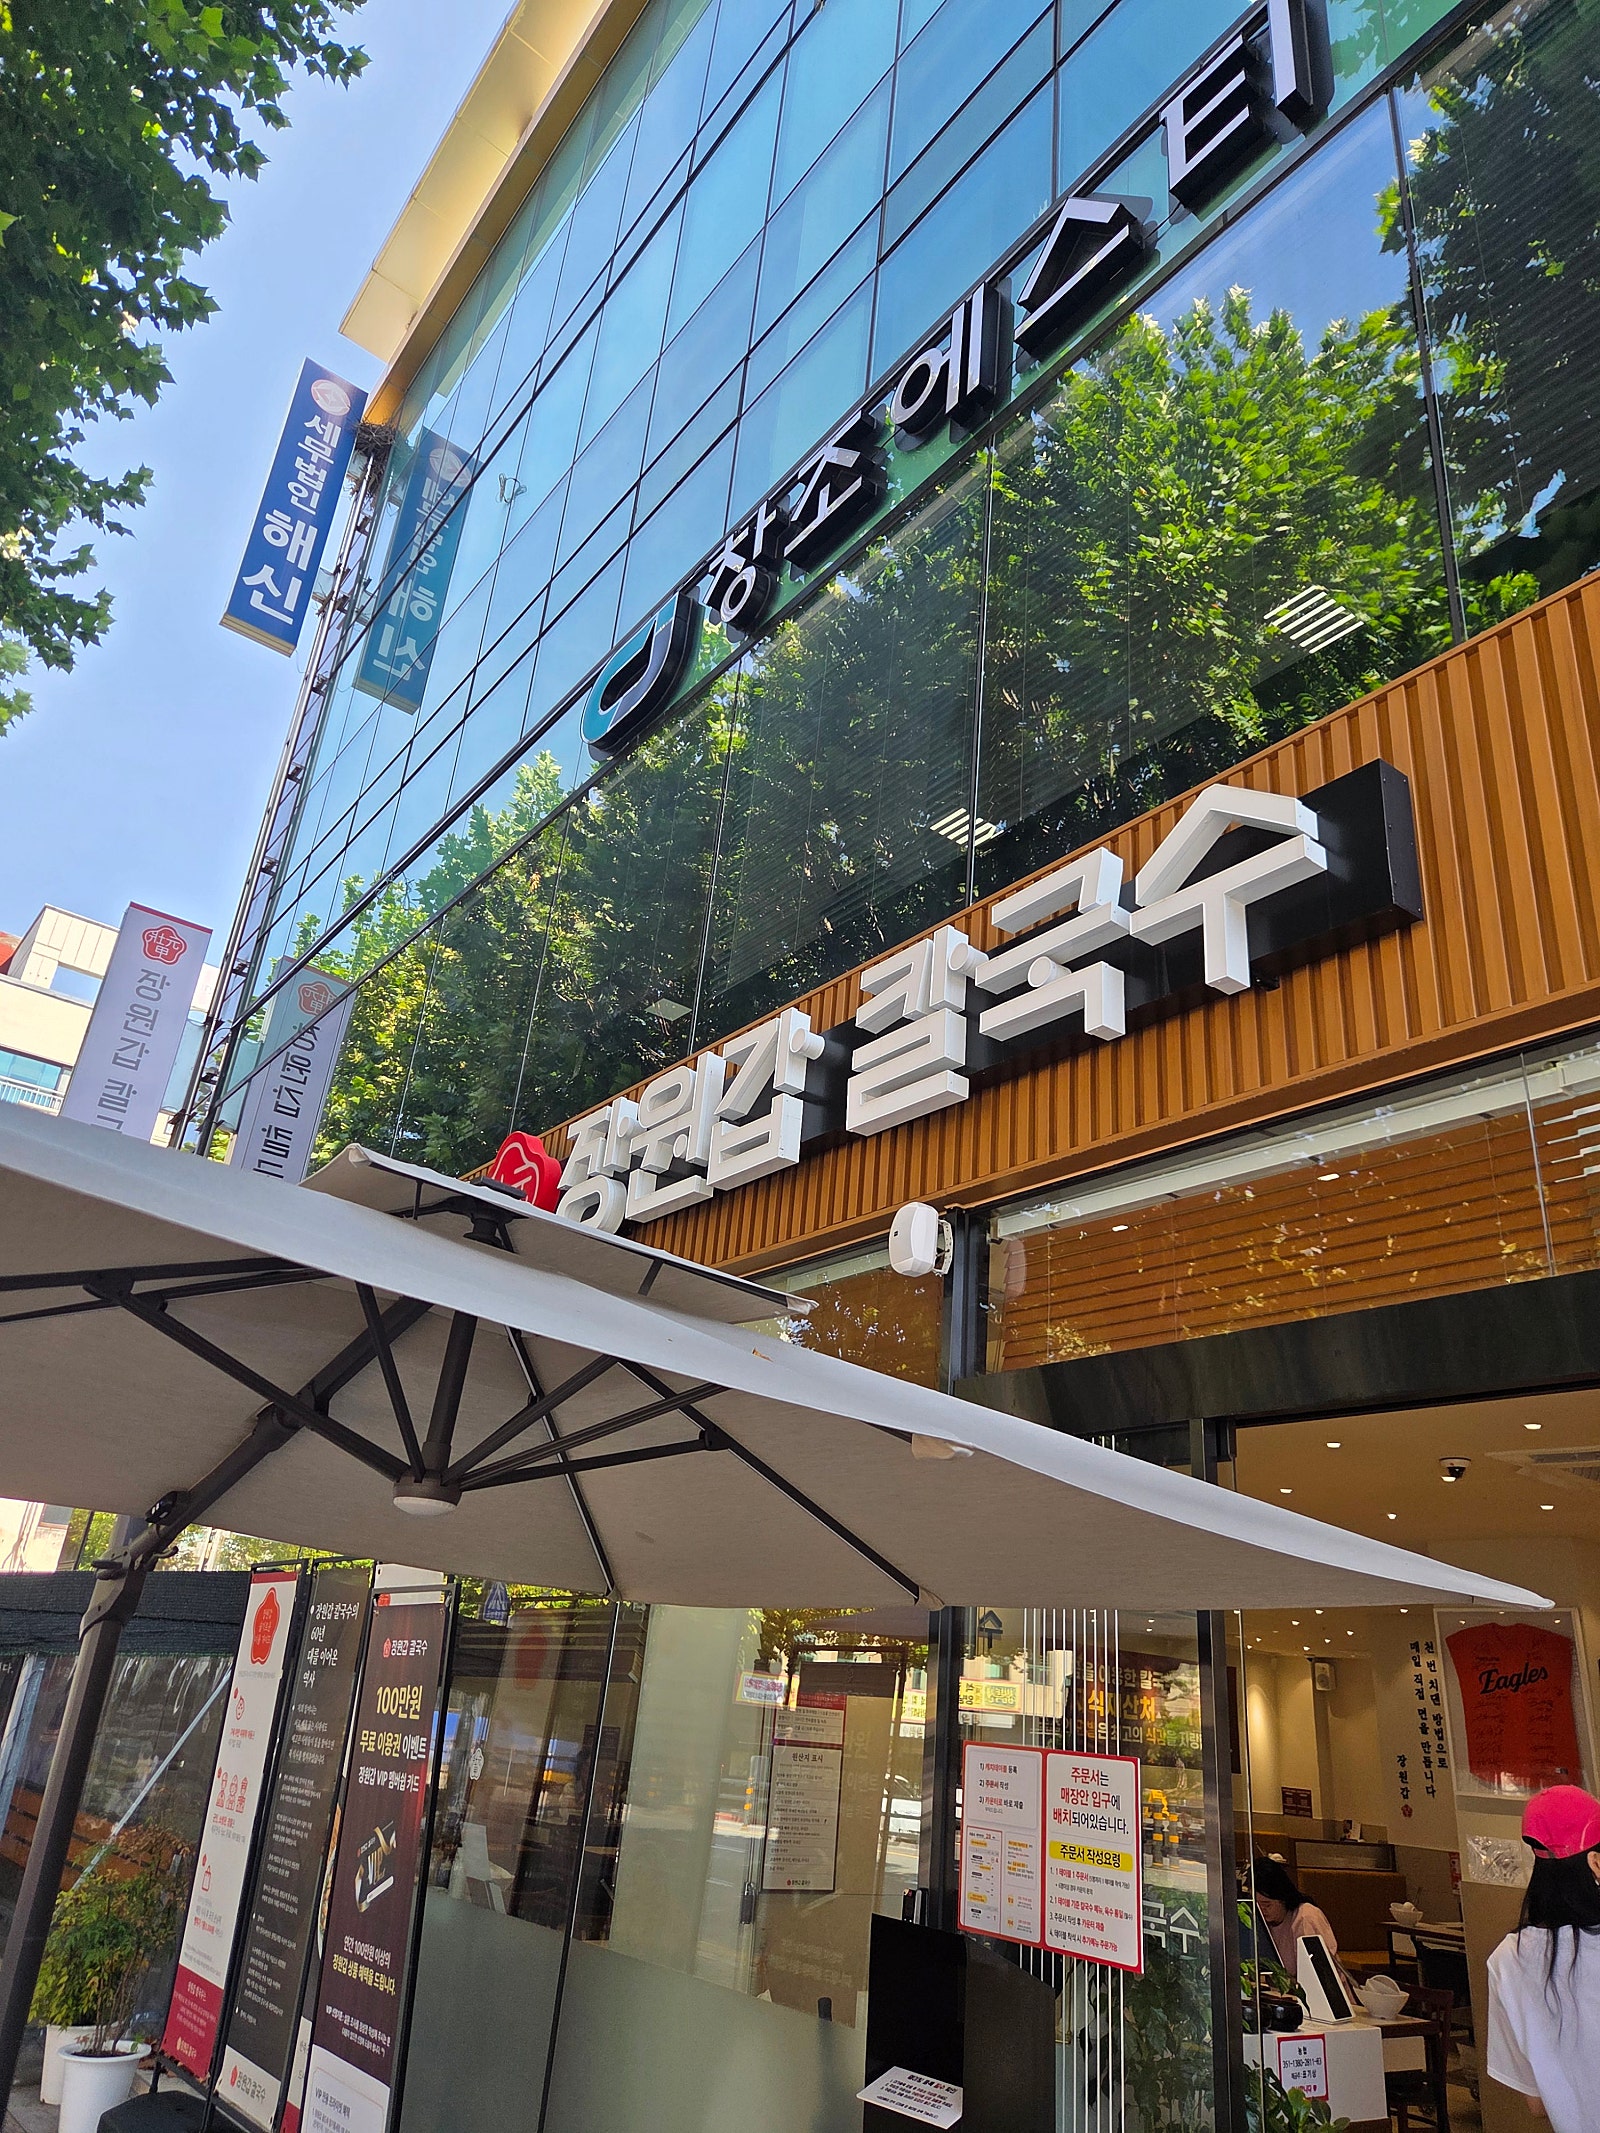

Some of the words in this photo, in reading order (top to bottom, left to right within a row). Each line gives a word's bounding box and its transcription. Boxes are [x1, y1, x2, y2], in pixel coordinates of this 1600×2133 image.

[703, 0, 1312, 624] 창조에스티
[286, 414, 342, 516] 세무법인
[241, 508, 319, 626] 해신
[110, 967, 171, 1073] 장원갑
[554, 1007, 826, 1235] 장원갑
[845, 782, 1328, 1138] 칼국수
[315, 1603, 334, 1620] 장원갑
[333, 1602, 360, 1621] 칼국수의
[311, 1625, 325, 1643] 60년
[307, 1648, 320, 1667] 대를
[320, 1648, 339, 1667] 이어온
[391, 1640, 409, 1656] 장원갑
[409, 1639, 428, 1657] 칼국수
[1409, 1640, 1422, 1669] 매일
[1423, 1640, 1435, 1655] 천
[1099, 1664, 1137, 1688] 이용한
[1426, 1659, 1438, 1674] 번
[1478, 1661, 1549, 1696] Eagles
[303, 1670, 316, 1689] 역사
[1413, 1673, 1426, 1702] 직접
[376, 1684, 423, 1720] 100만원
[1428, 1678, 1441, 1707] 치댄
[1417, 1707, 1430, 1736] 면을
[360, 1730, 377, 1753] 무료
[377, 1731, 402, 1758] 이용권
[402, 1734, 427, 1760] 이벤트
[1146, 1726, 1177, 1748] 식감을
[1432, 1712, 1449, 1770] 방법으로
[792, 1752, 810, 1764] 원산지
[811, 1753, 823, 1764] 표시
[1008, 1765, 1018, 1774] 등록
[1420, 1740, 1437, 1799] 만듭니다
[358, 1766, 377, 1786] 장원갑
[377, 1769, 388, 1786] VIP
[406, 1773, 420, 1793] 카드
[985, 1780, 999, 1789] 주문서
[999, 1782, 1009, 1791] 작성
[1071, 1766, 1109, 1787] 주문서는
[1396, 1754, 1411, 1800] 장원갑
[1003, 1799, 1013, 1808] 바로
[1060, 1787, 1089, 1806] 매장안
[1092, 1791, 1121, 1811] 입구에
[1053, 1807, 1129, 1835] 배치되어있습니다.
[1060, 1844, 1085, 1862] 주문서
[1086, 1848, 1121, 1869] 작성요령
[1059, 1868, 1071, 1879] 테이블
[1075, 1870, 1088, 1882] 주문서
[1057, 1897, 1070, 1908] 테이블
[1080, 1901, 1093, 1912] 칼국수
[1054, 1912, 1067, 1923] 주문서
[1067, 1915, 1076, 1926] 작성
[1054, 1929, 1067, 1940] 테이블
[343, 1935, 355, 1954] 연간
[354, 1940, 375, 1962] 100만원
[374, 1948, 391, 1970] 이상의
[332, 1953, 348, 1975] 장원갑
[347, 1960, 359, 1980] 상품
[359, 1964, 374, 1987] 혜택을
[373, 1971, 396, 1997] 드립니다.
